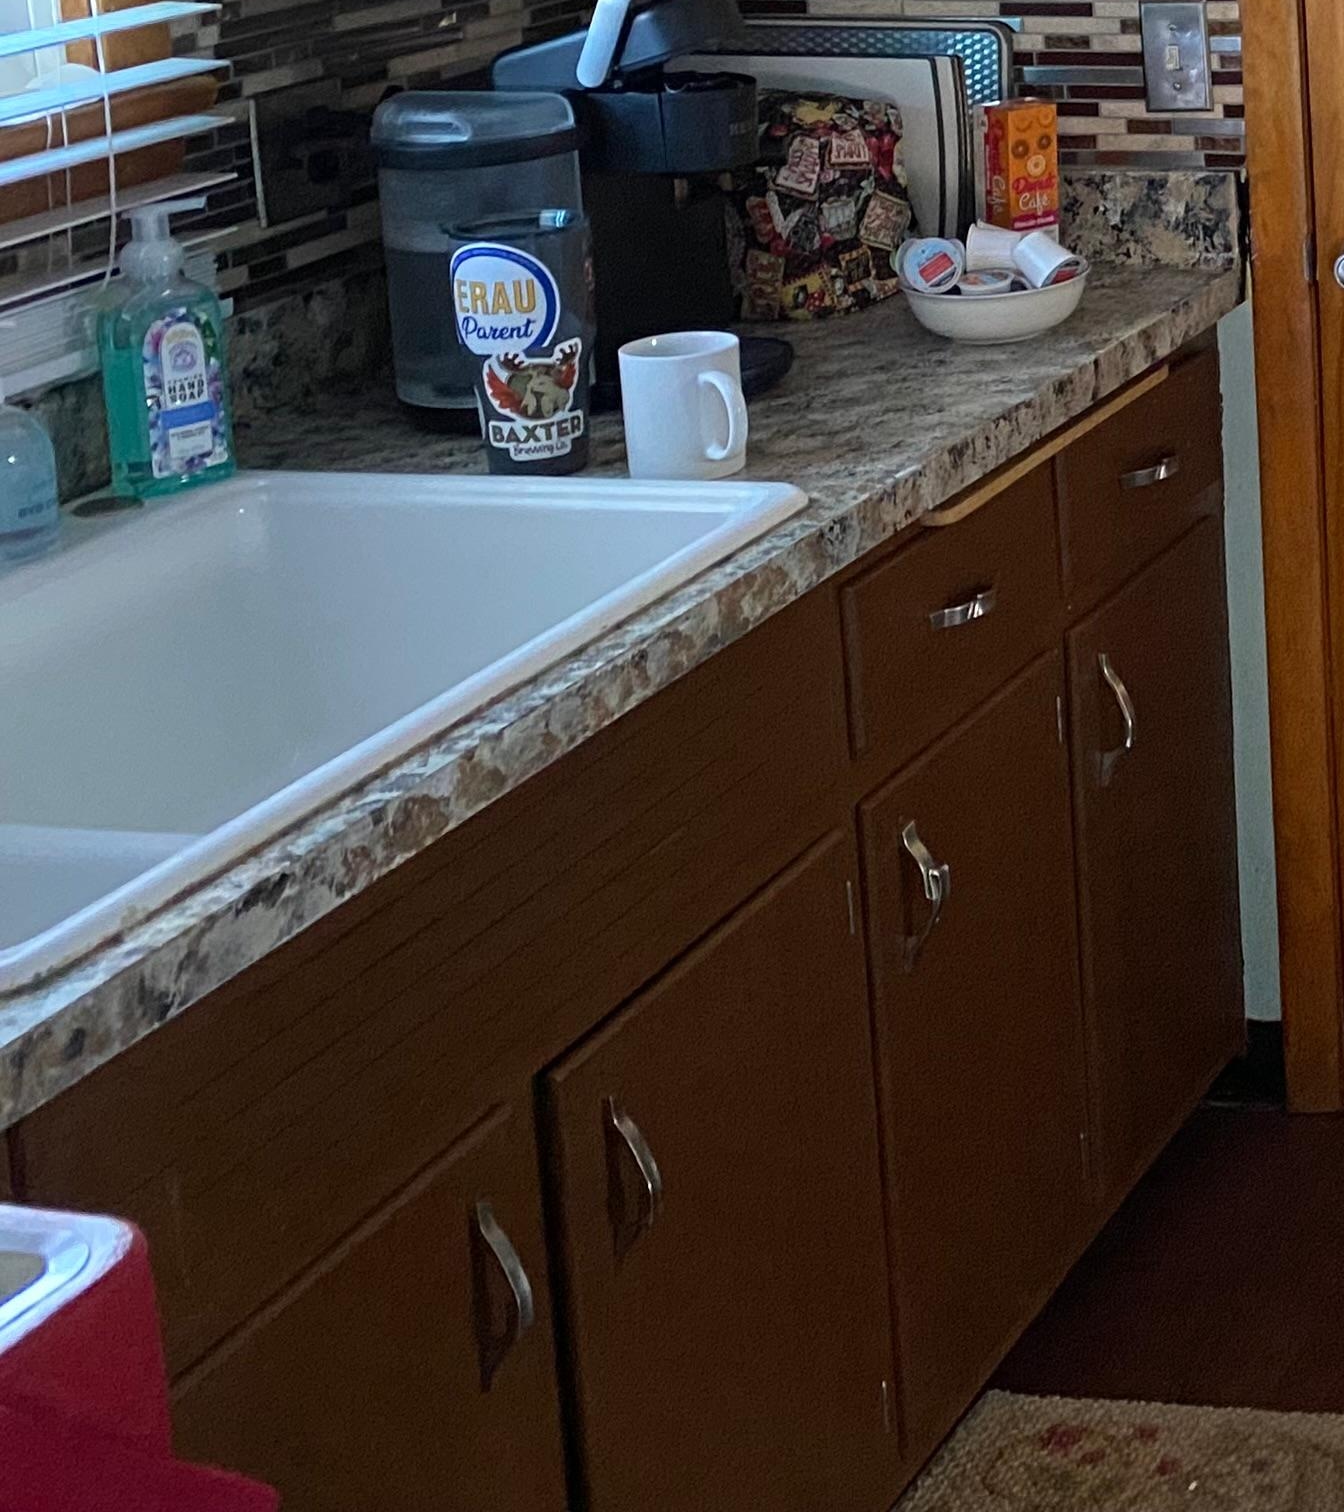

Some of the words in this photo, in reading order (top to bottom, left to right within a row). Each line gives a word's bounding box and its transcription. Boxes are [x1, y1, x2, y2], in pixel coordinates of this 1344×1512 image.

[455, 278, 537, 315] ERAU
[461, 316, 537, 341] Parent
[168, 379, 205, 395] HAND
[170, 389, 205, 404] SOAP
[491, 416, 583, 445] BAXTER
